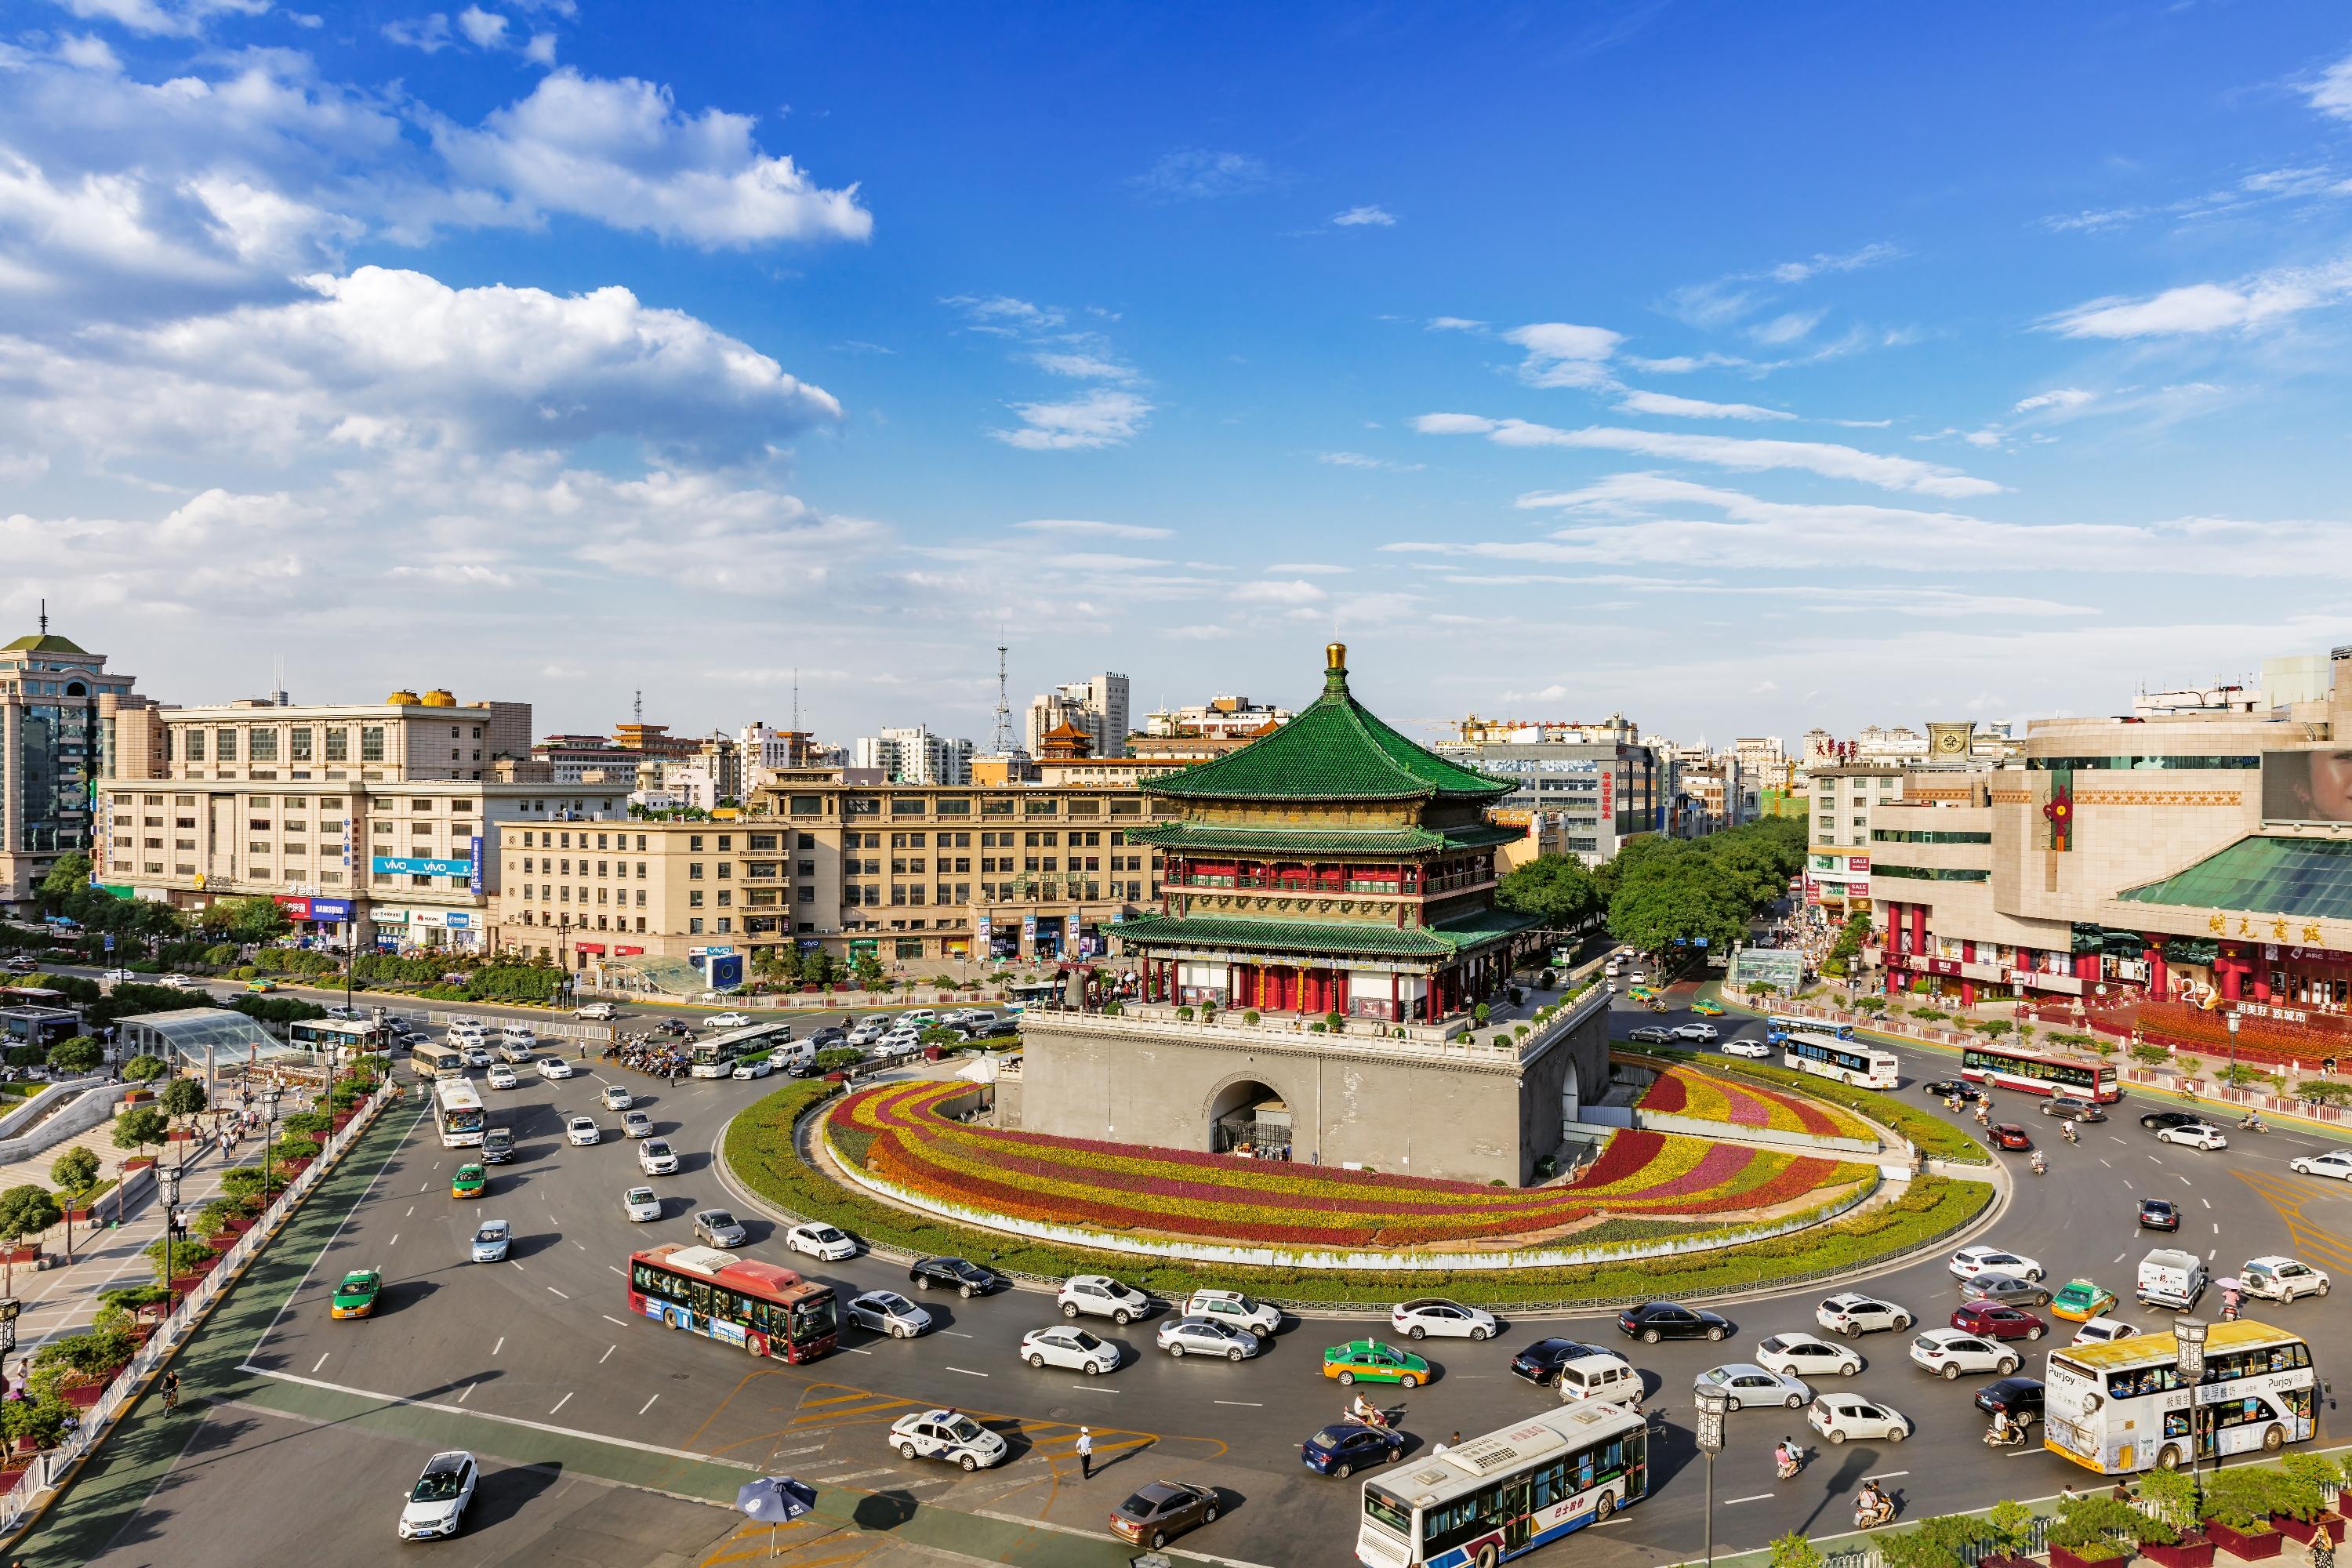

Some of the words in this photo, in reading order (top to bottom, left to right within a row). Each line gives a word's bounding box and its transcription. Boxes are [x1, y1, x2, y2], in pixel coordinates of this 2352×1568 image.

[384, 859, 407, 870] vivo
[423, 861, 446, 872] vivo
[315, 905, 343, 914] SAMSUNG
[1938, 960, 1951, 970] MUJI
[2237, 1003, 2267, 1017] 用美好
[2273, 1008, 2307, 1023] 致城市
[2049, 1366, 2075, 1385] Purjoy
[2268, 1376, 2293, 1388] Purjoy
[1555, 1497, 1584, 1518] 巴士股份
